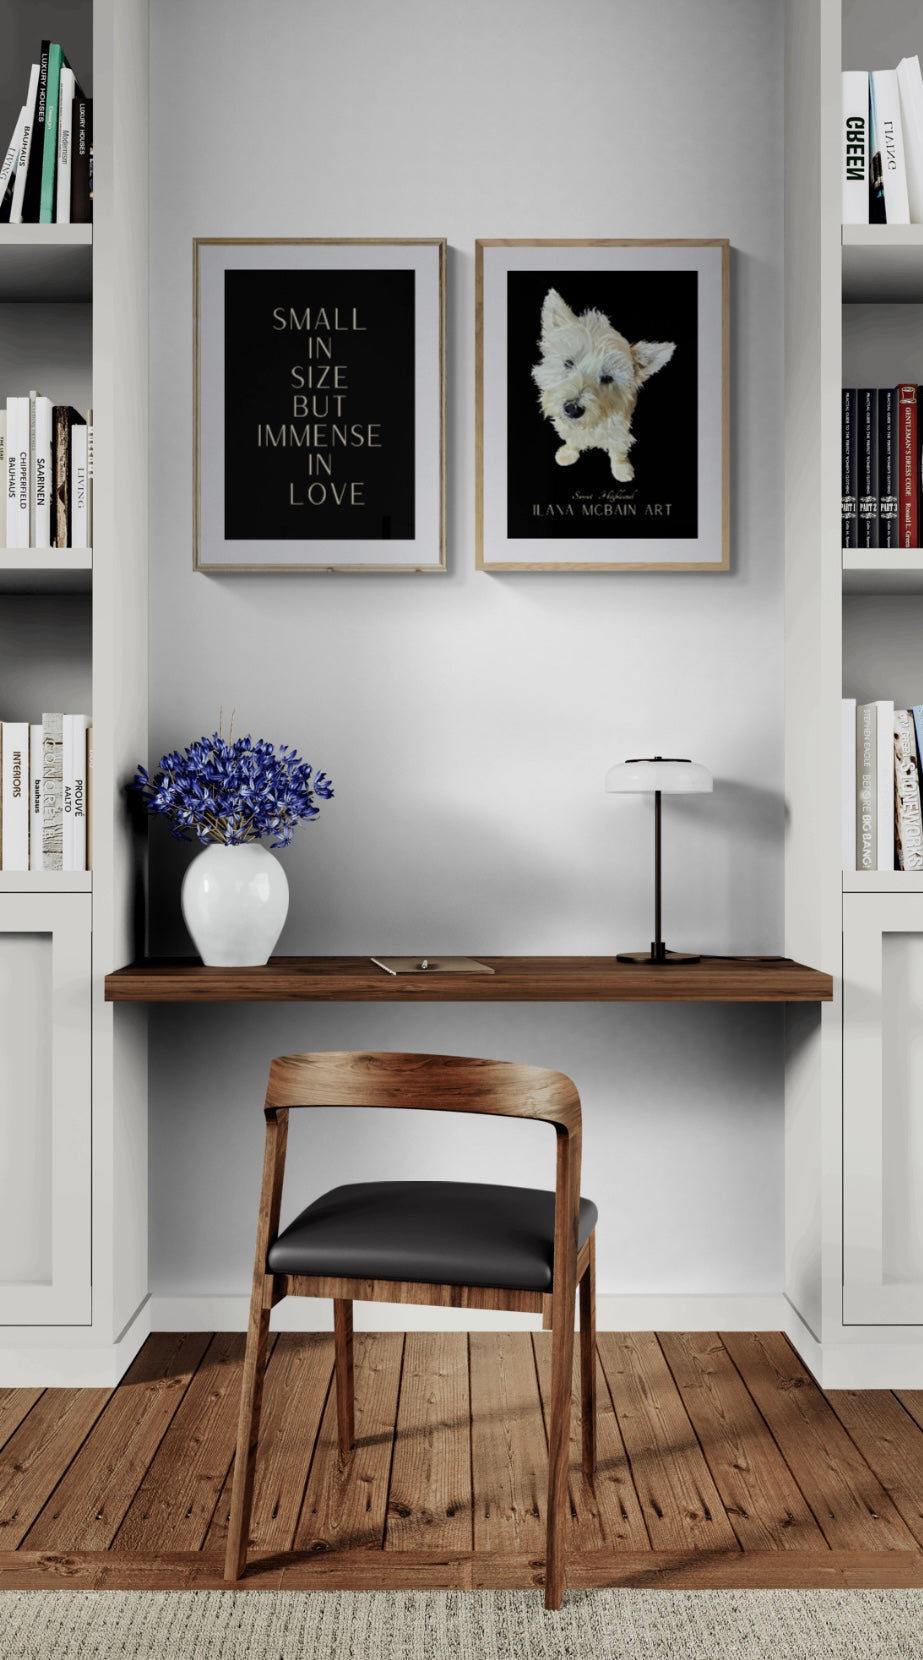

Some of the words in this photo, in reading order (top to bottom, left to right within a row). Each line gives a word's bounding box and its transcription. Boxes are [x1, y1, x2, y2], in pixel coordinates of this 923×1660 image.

[40, 53, 48, 86] LUXURY
[19, 126, 30, 167] BAUHAUS
[62, 130, 70, 164] Modernism
[0, 148, 16, 180] LIVING
[273, 307, 366, 330] SMALL
[309, 337, 332, 359] IN
[291, 366, 348, 389] SIZE
[294, 395, 347, 417] BUT
[258, 424, 382, 447] IMMENSE
[309, 454, 332, 475] IN
[37, 458, 45, 506] SAARINEN
[290, 482, 365, 505] LOVE
[533, 504, 574, 516] ILANA
[582, 504, 636, 516] MCBAIN
[645, 504, 672, 516] ART
[860, 503, 871, 511] PART
[872, 503, 877, 511] 2
[880, 503, 892, 511] PART
[864, 709, 872, 740] STEPHEN
[864, 742, 872, 767] EAGLE
[13, 752, 21, 798] INTERIORS
[75, 780, 85, 817] PROUVÉ
[862, 774, 871, 812] BEFORE
[862, 814, 871, 831] BIG
[862, 833, 871, 868] BANG!
